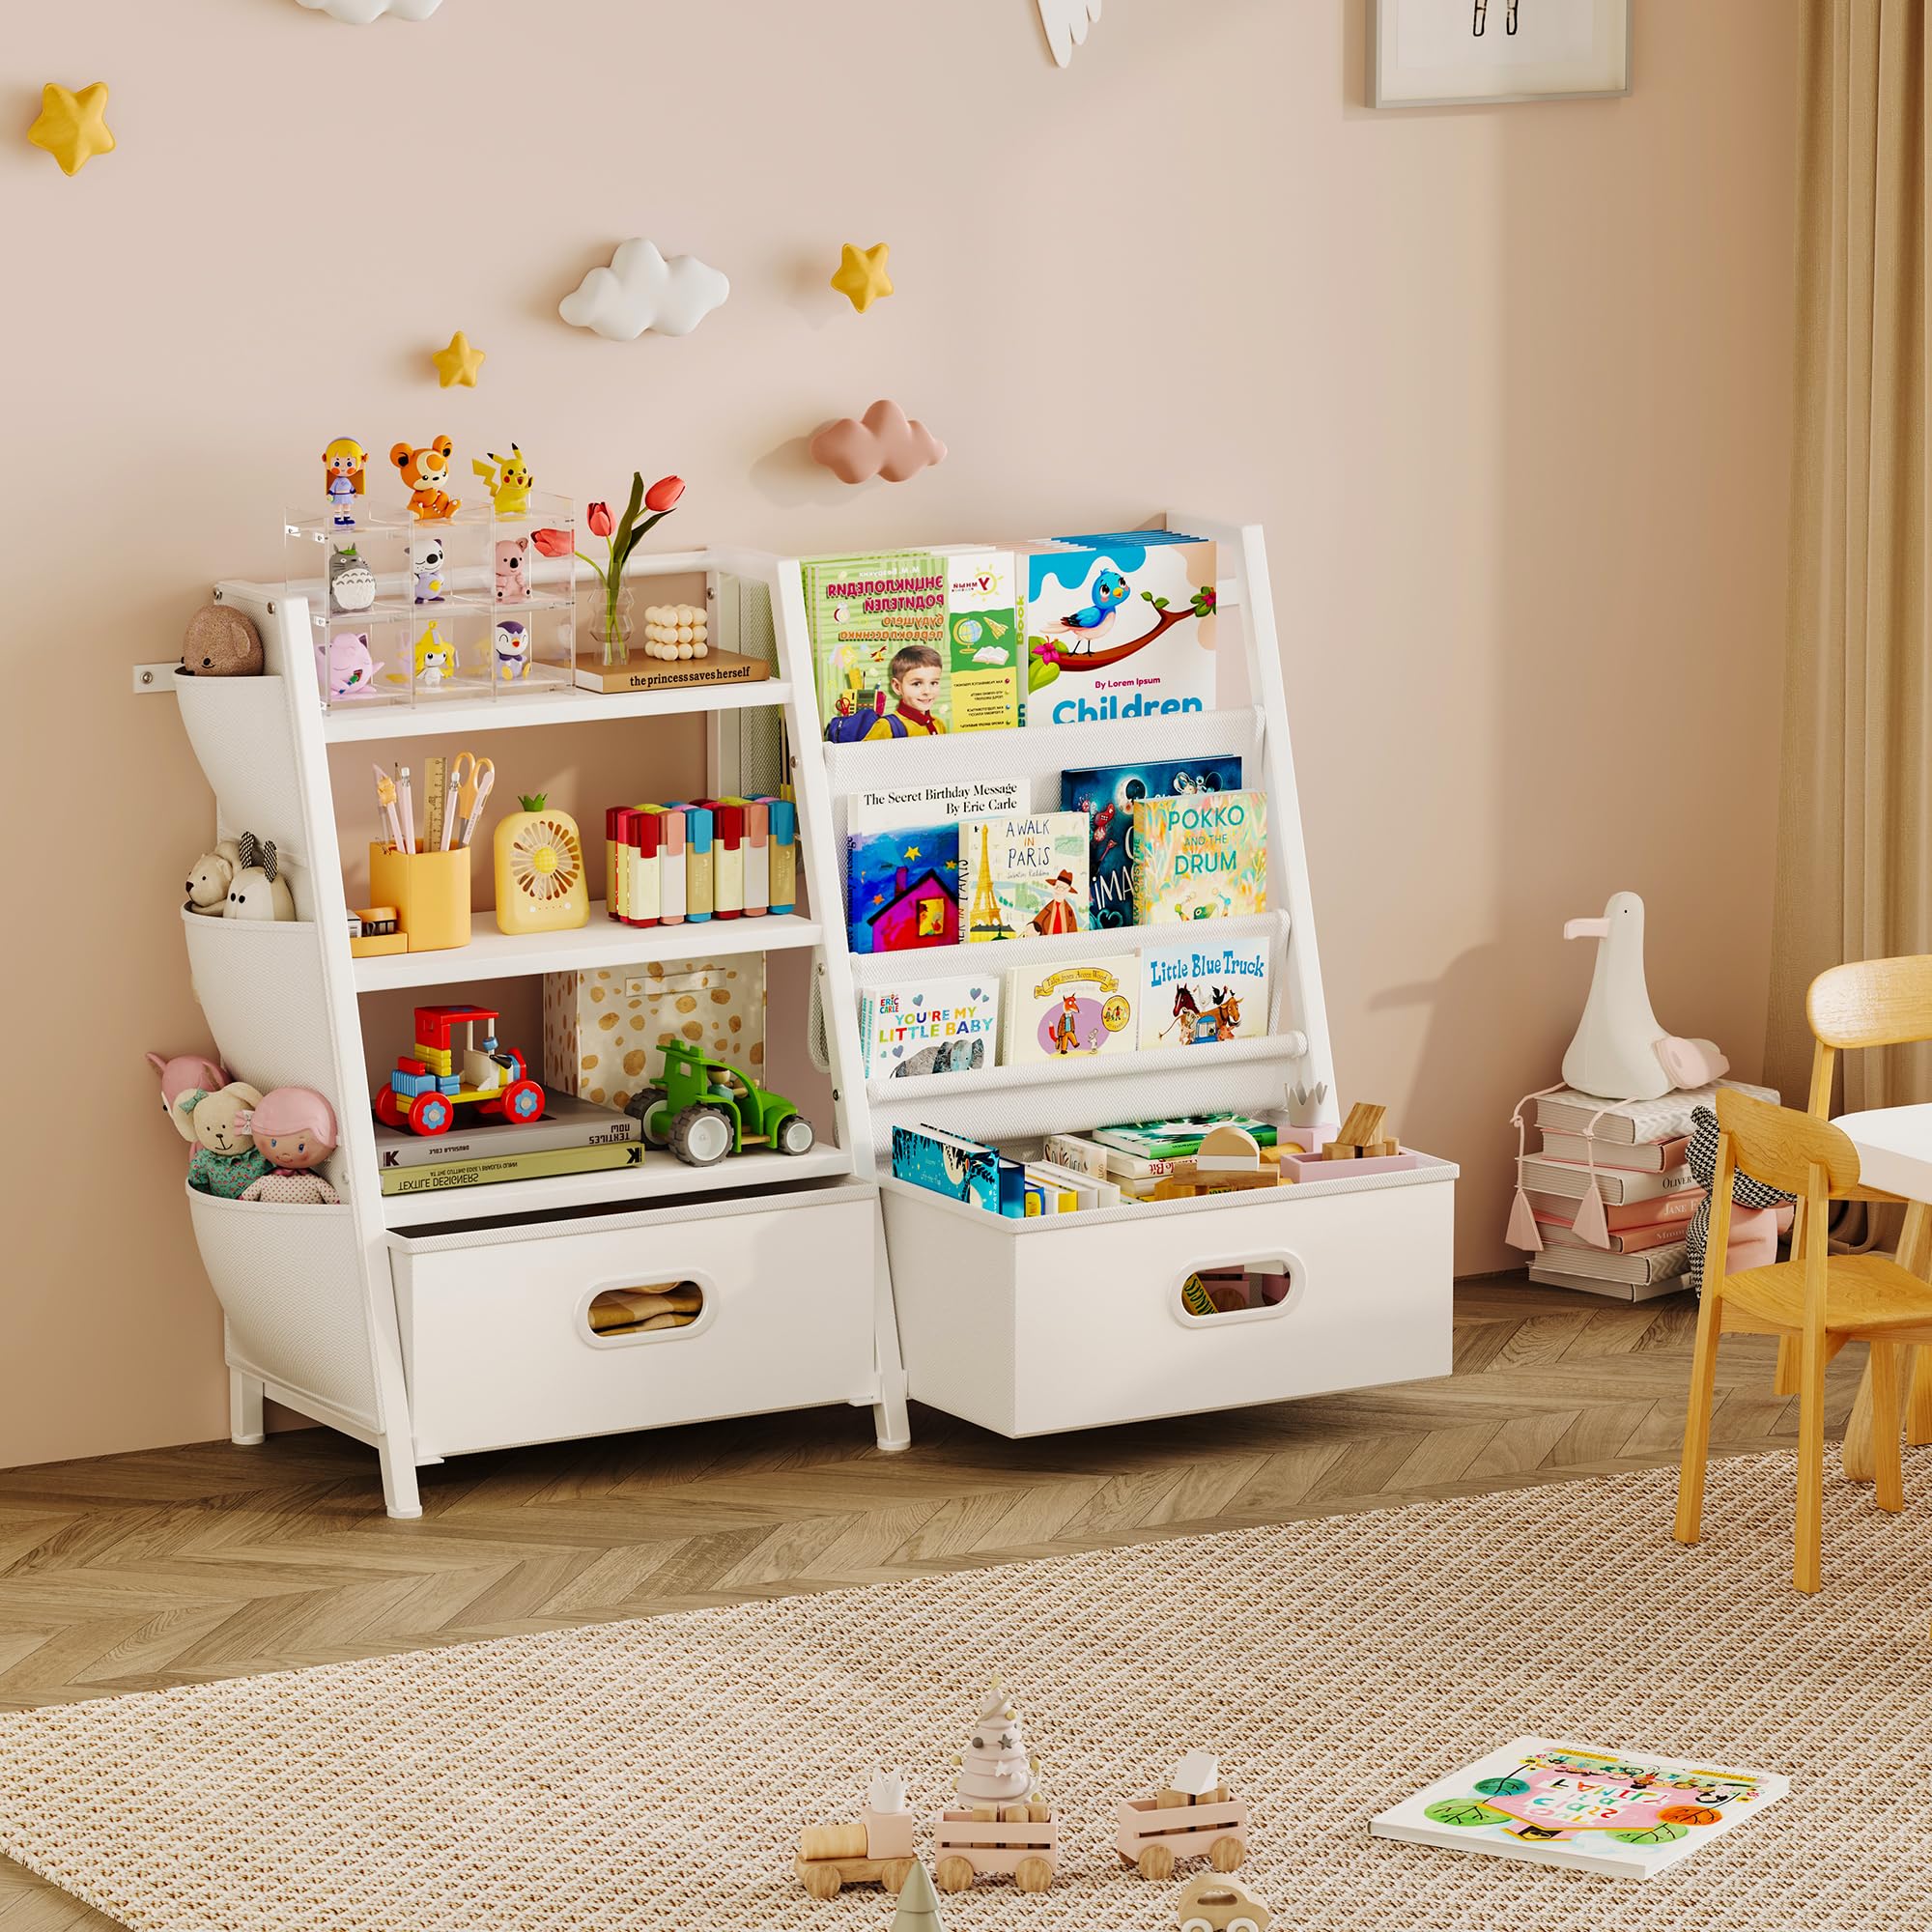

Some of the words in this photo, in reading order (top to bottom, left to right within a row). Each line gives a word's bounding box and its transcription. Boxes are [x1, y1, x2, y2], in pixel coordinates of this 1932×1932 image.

[630, 675, 646, 687] the
[647, 671, 689, 687] princess
[689, 670, 716, 682] saves
[716, 667, 751, 679] herself
[1095, 680, 1106, 690] By
[1108, 678, 1135, 688] Lorem
[1136, 677, 1161, 687] Ipsum
[1052, 694, 1203, 724] Children
[864, 793, 885, 806] The
[888, 792, 922, 805] Secret
[925, 787, 971, 802] Birthday
[974, 783, 1018, 797] Message
[946, 802, 960, 816] By
[963, 800, 985, 813] Eric
[988, 798, 1018, 811] Carle
[1168, 805, 1245, 831] POKKO
[1006, 822, 1015, 838] A
[1018, 819, 1050, 835] WALK
[1024, 837, 1035, 847] IN
[1184, 836, 1206, 847] AND
[1208, 834, 1227, 845] THE
[1008, 847, 1050, 868] PARIS
[1175, 850, 1237, 875] DRUM
[1151, 958, 1188, 988] Little
[1191, 953, 1222, 978] Blue
[1223, 950, 1264, 978] Truck
[895, 1009, 950, 1026] YOU'RE
[954, 1006, 978, 1019] MY
[879, 1024, 939, 1043] LITTLE
[945, 1018, 994, 1037] BABY
[589, 1132, 630, 1145] TEXTILES
[1662, 1176, 1692, 1189] OLIVER
[1664, 1203, 1687, 1216] JANE
